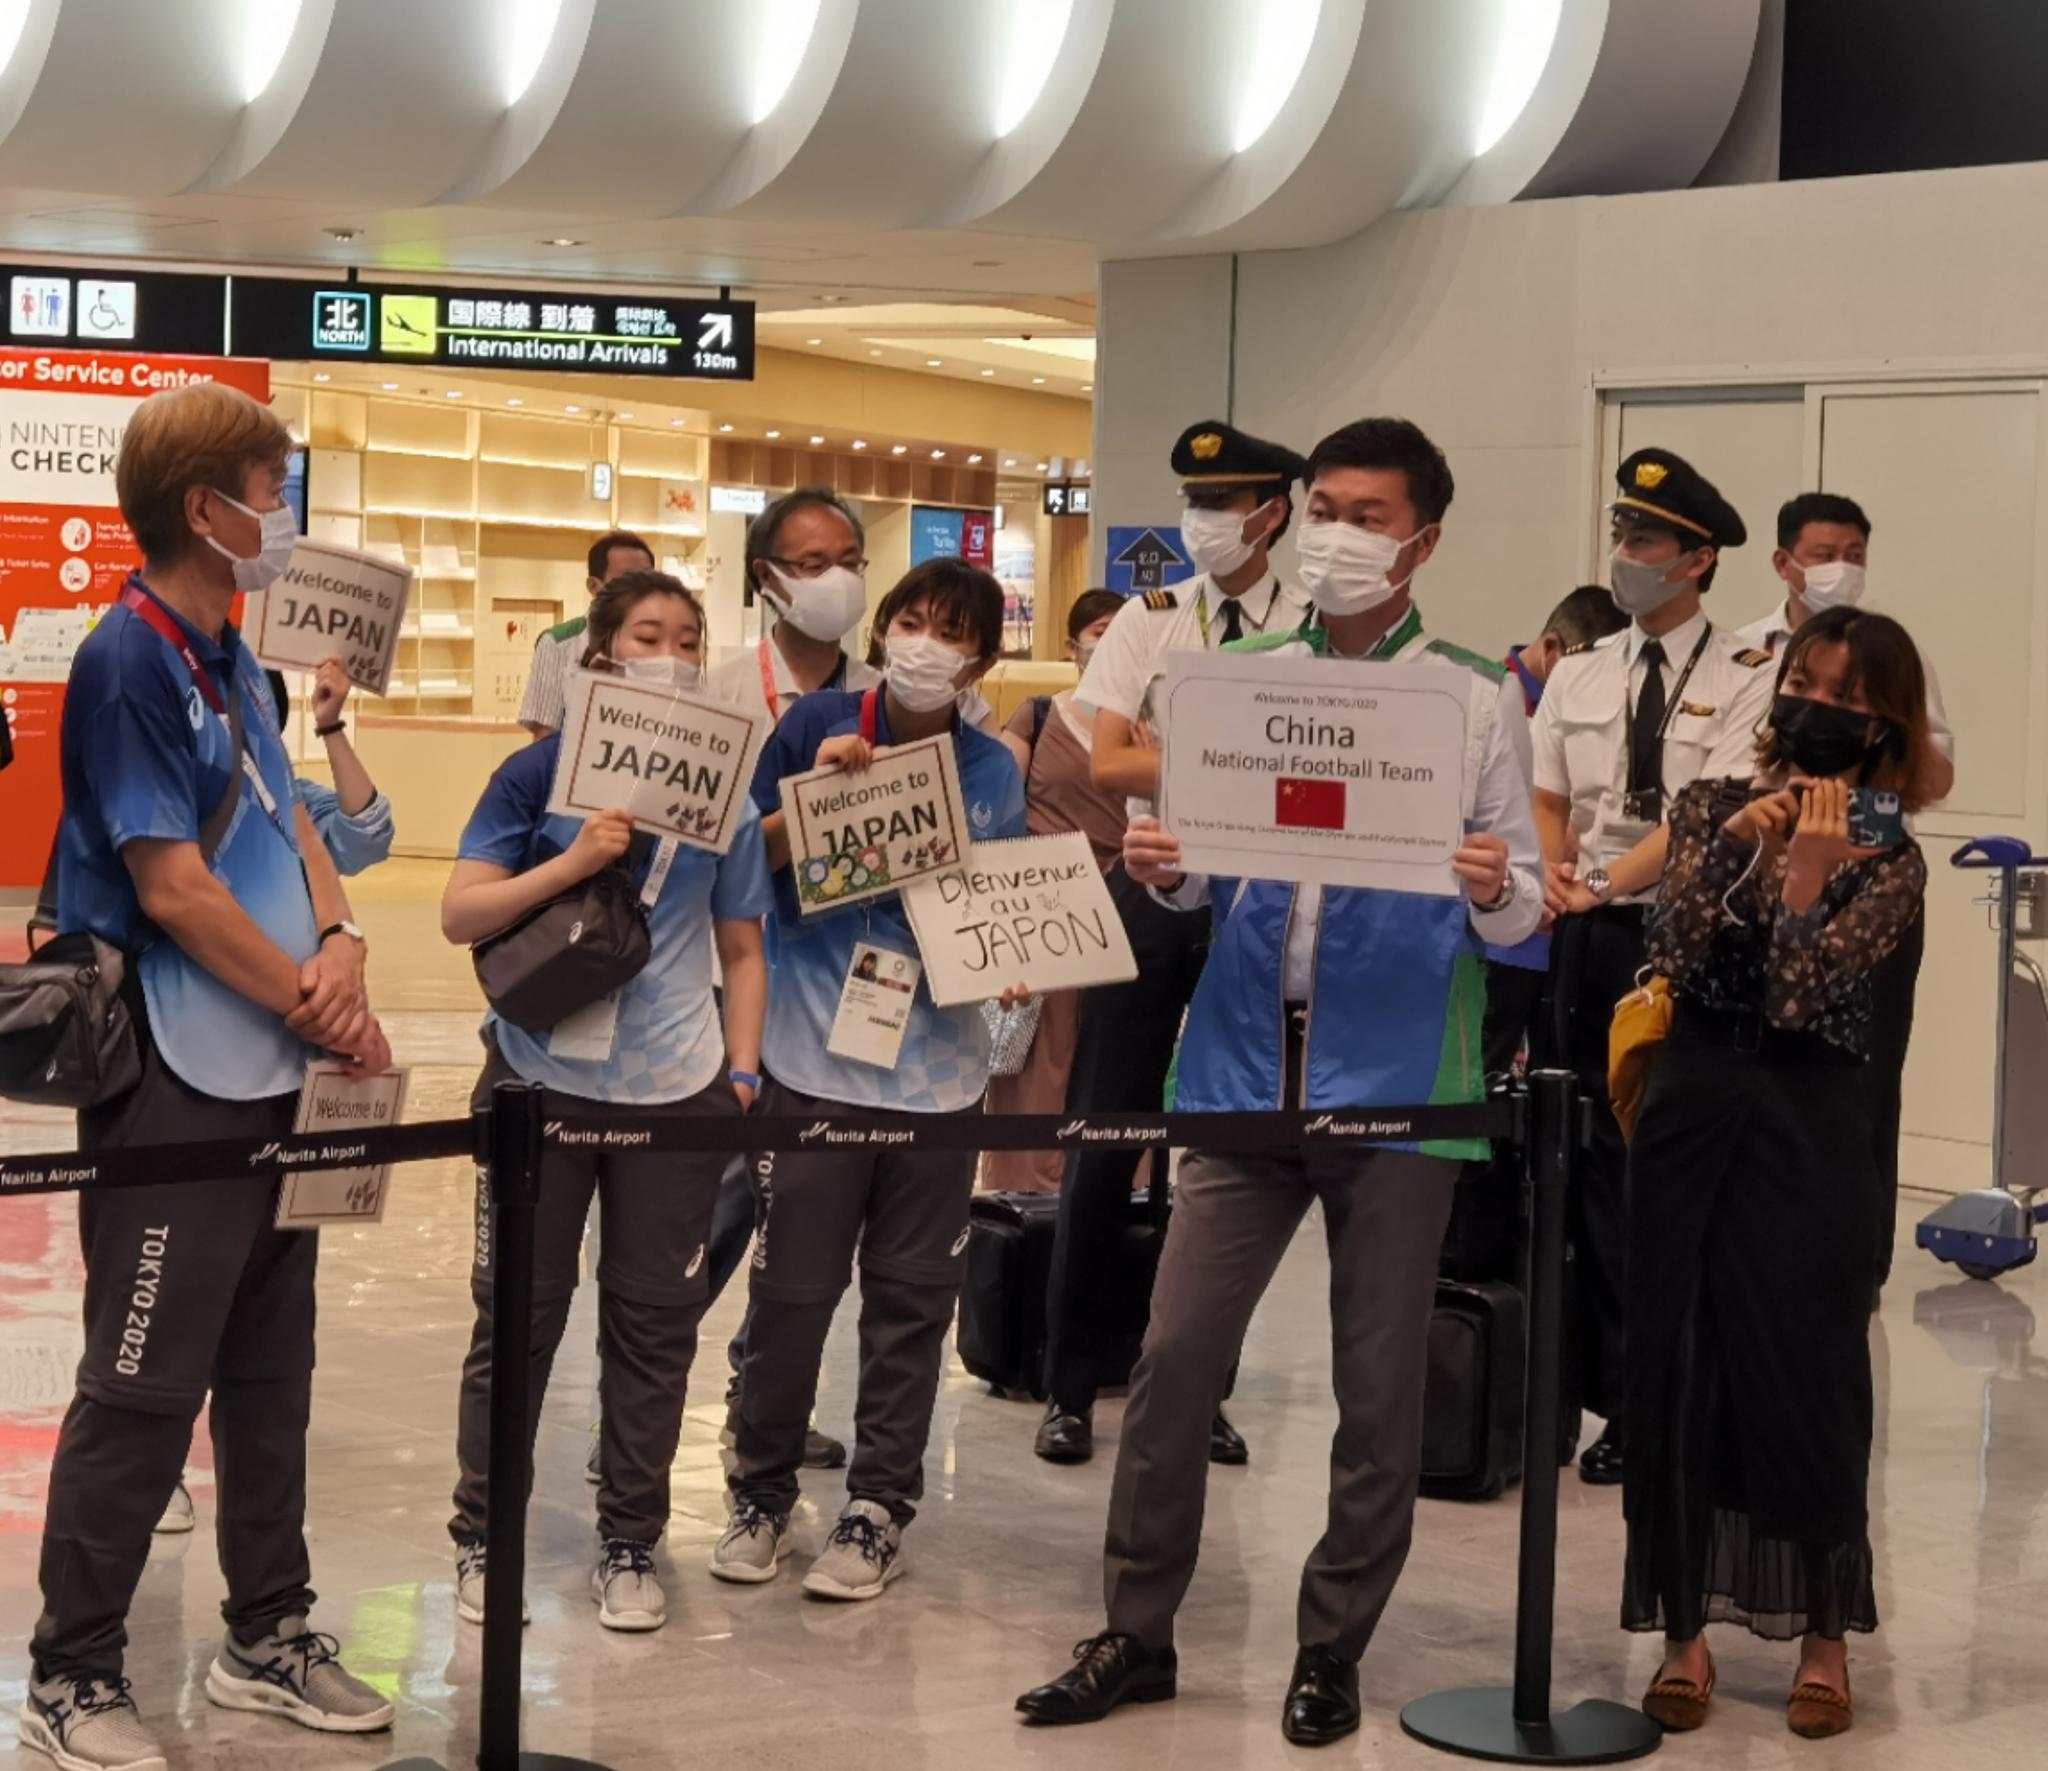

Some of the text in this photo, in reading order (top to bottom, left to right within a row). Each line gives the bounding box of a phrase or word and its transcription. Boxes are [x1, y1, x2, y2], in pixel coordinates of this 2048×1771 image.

[326, 299, 358, 329] 北
[449, 299, 595, 332] 国際線 到着
[319, 329, 364, 344] NORTH
[449, 335, 668, 365] International Arrivals
[0, 358, 213, 388] or Service Center
[693, 351, 737, 370] 130m
[11, 421, 121, 448] NINTEN
[11, 448, 117, 475] CHECK
[284, 567, 393, 611] Welcome to
[278, 597, 385, 653] JAPAN
[599, 705, 730, 755] Welcome to
[1266, 714, 1356, 749] China
[591, 740, 722, 801] JAPAN
[1202, 748, 1433, 783] National Football Team
[809, 771, 930, 818] Welcome to
[822, 800, 939, 855] JAPAN
[991, 897, 1030, 916] au
[955, 908, 1109, 971] JAPON
[314, 1097, 367, 1120] Welcome
[559, 1130, 651, 1147] Narita Airport
[826, 1130, 915, 1145] Narita Airport
[1082, 1126, 1167, 1142] Narita Airport
[1329, 1118, 1411, 1136] Narita Airport
[276, 1143, 366, 1164] Narita Airport
[1, 1166, 97, 1187] Narita Airport
[477, 1165, 490, 1267] KYO 2020
[115, 1225, 169, 1376] TOKYO 2020
